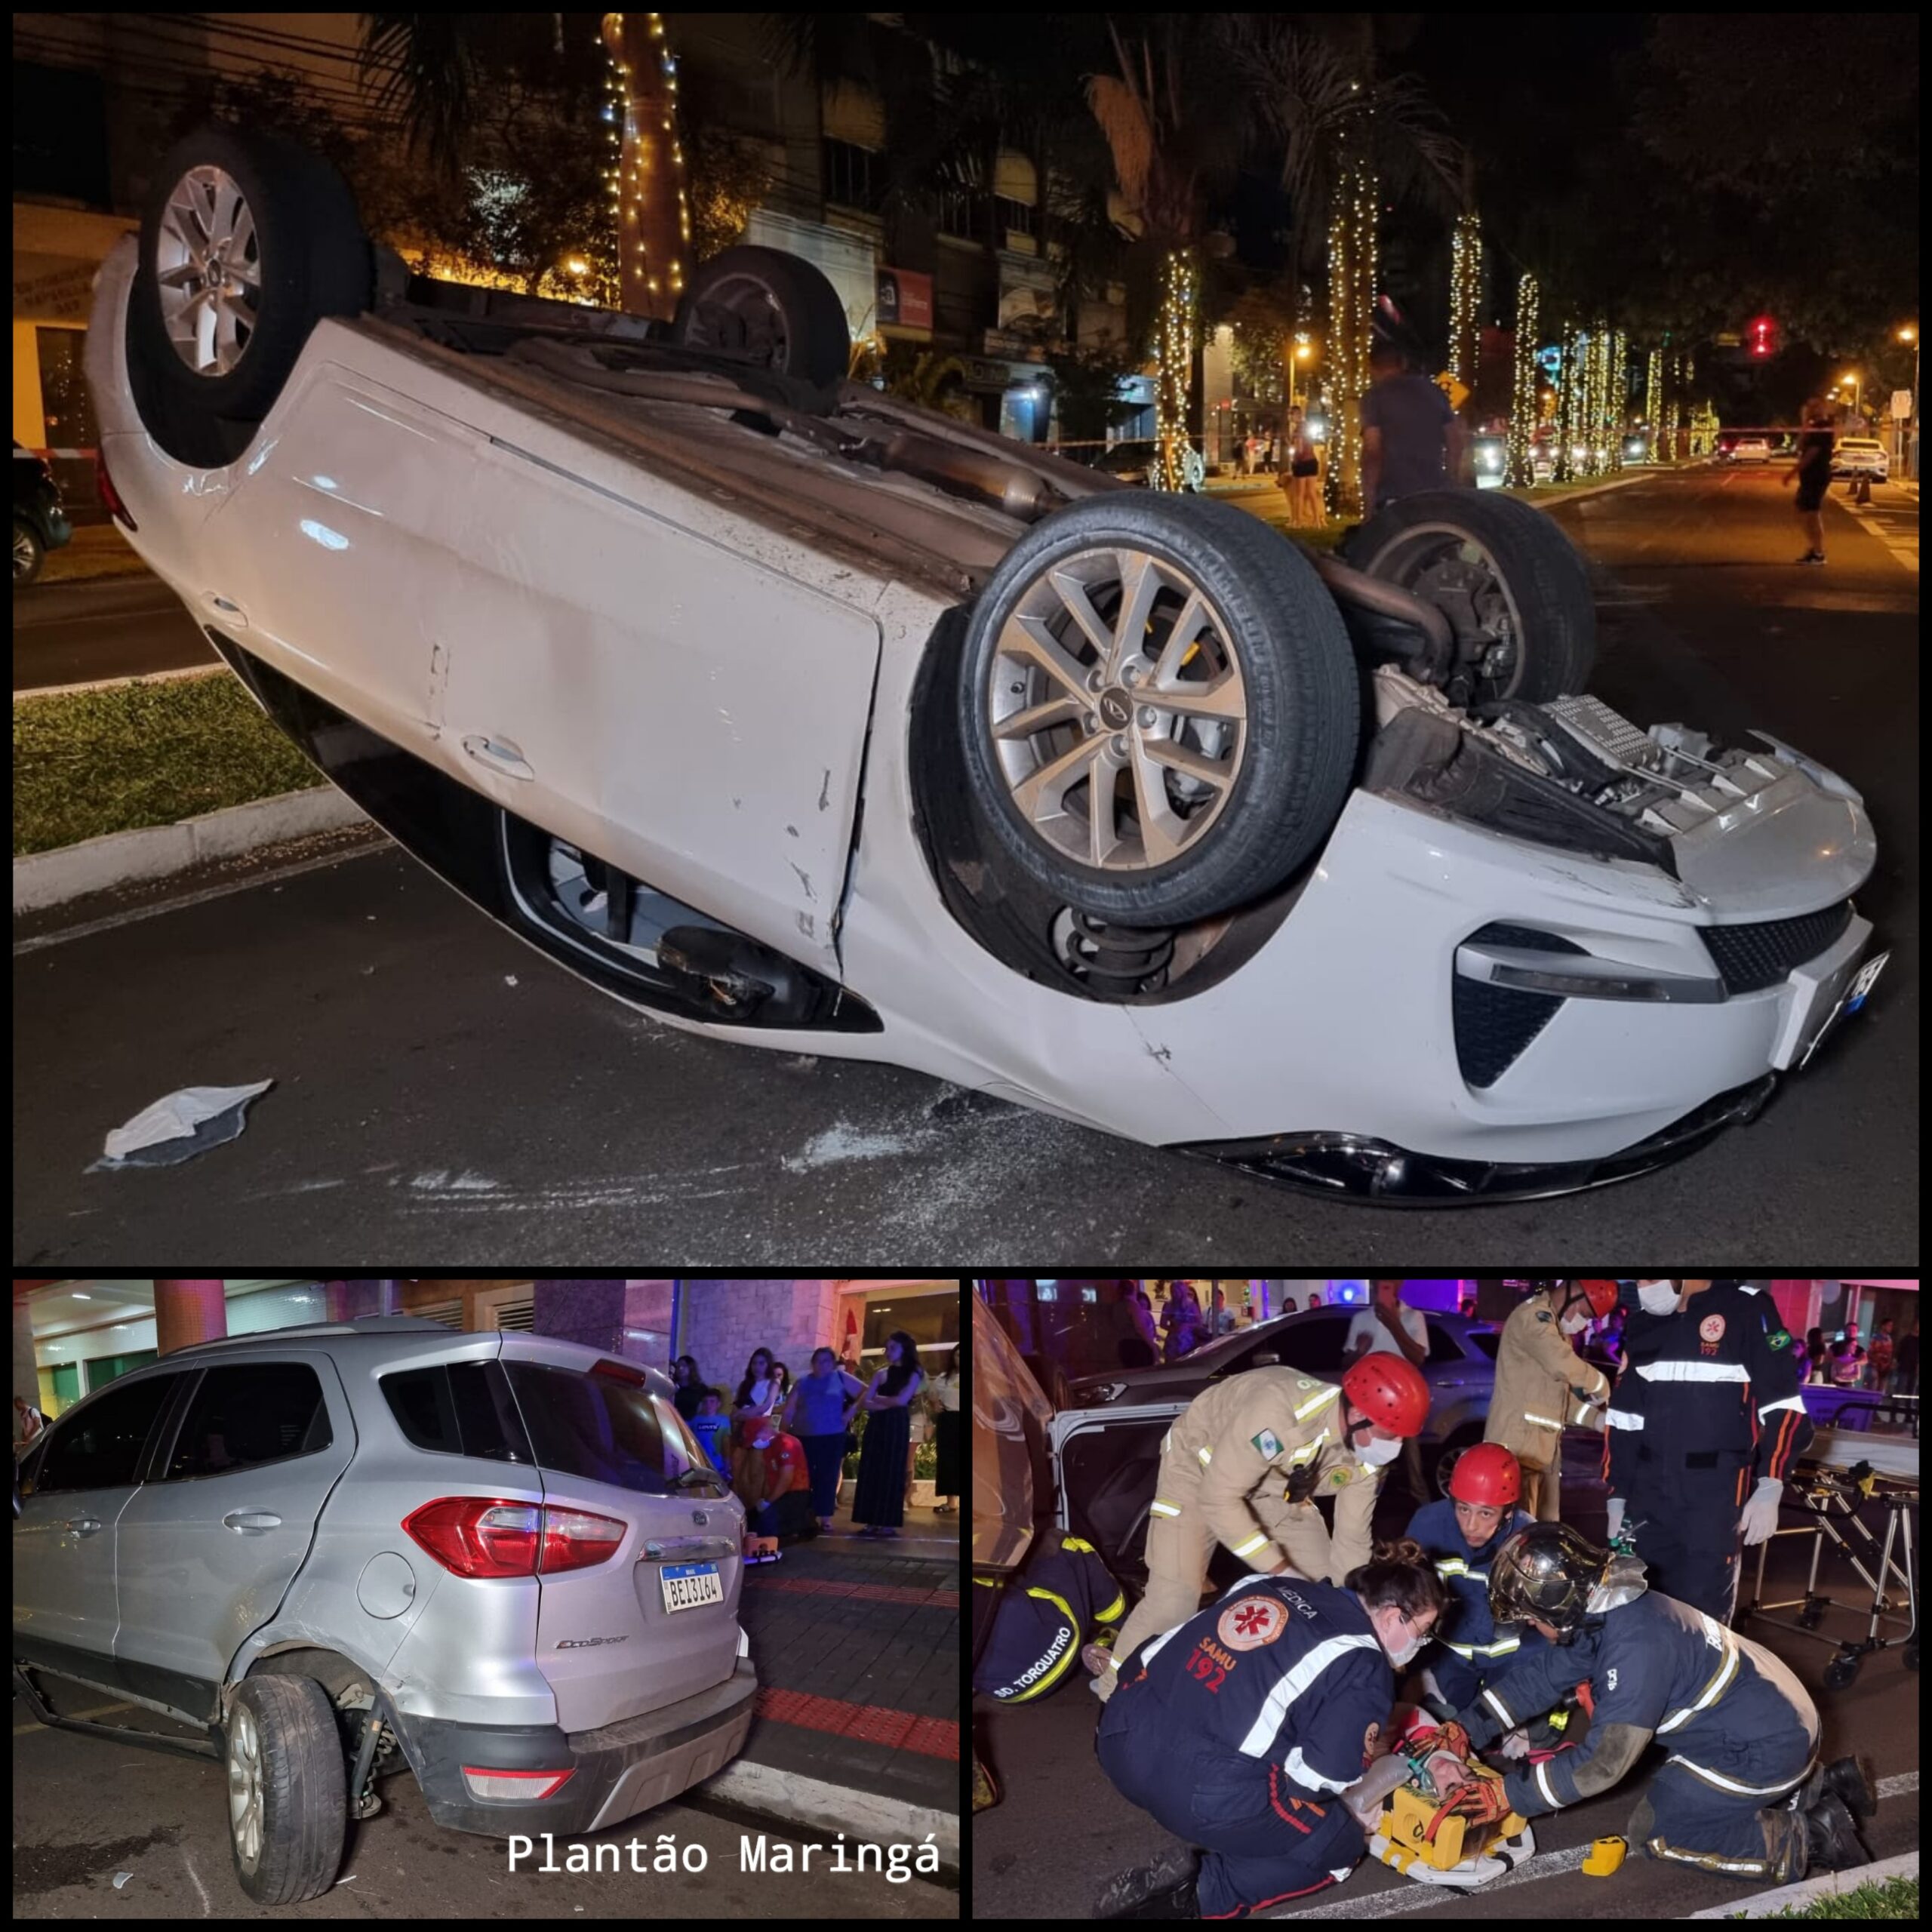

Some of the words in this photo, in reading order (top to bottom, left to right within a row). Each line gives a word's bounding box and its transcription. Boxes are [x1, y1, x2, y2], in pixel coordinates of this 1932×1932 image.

[1013, 1627, 1071, 1688] TORQUATRO
[1186, 1647, 1226, 1694] 192
[1198, 1636, 1237, 1671] SAMU
